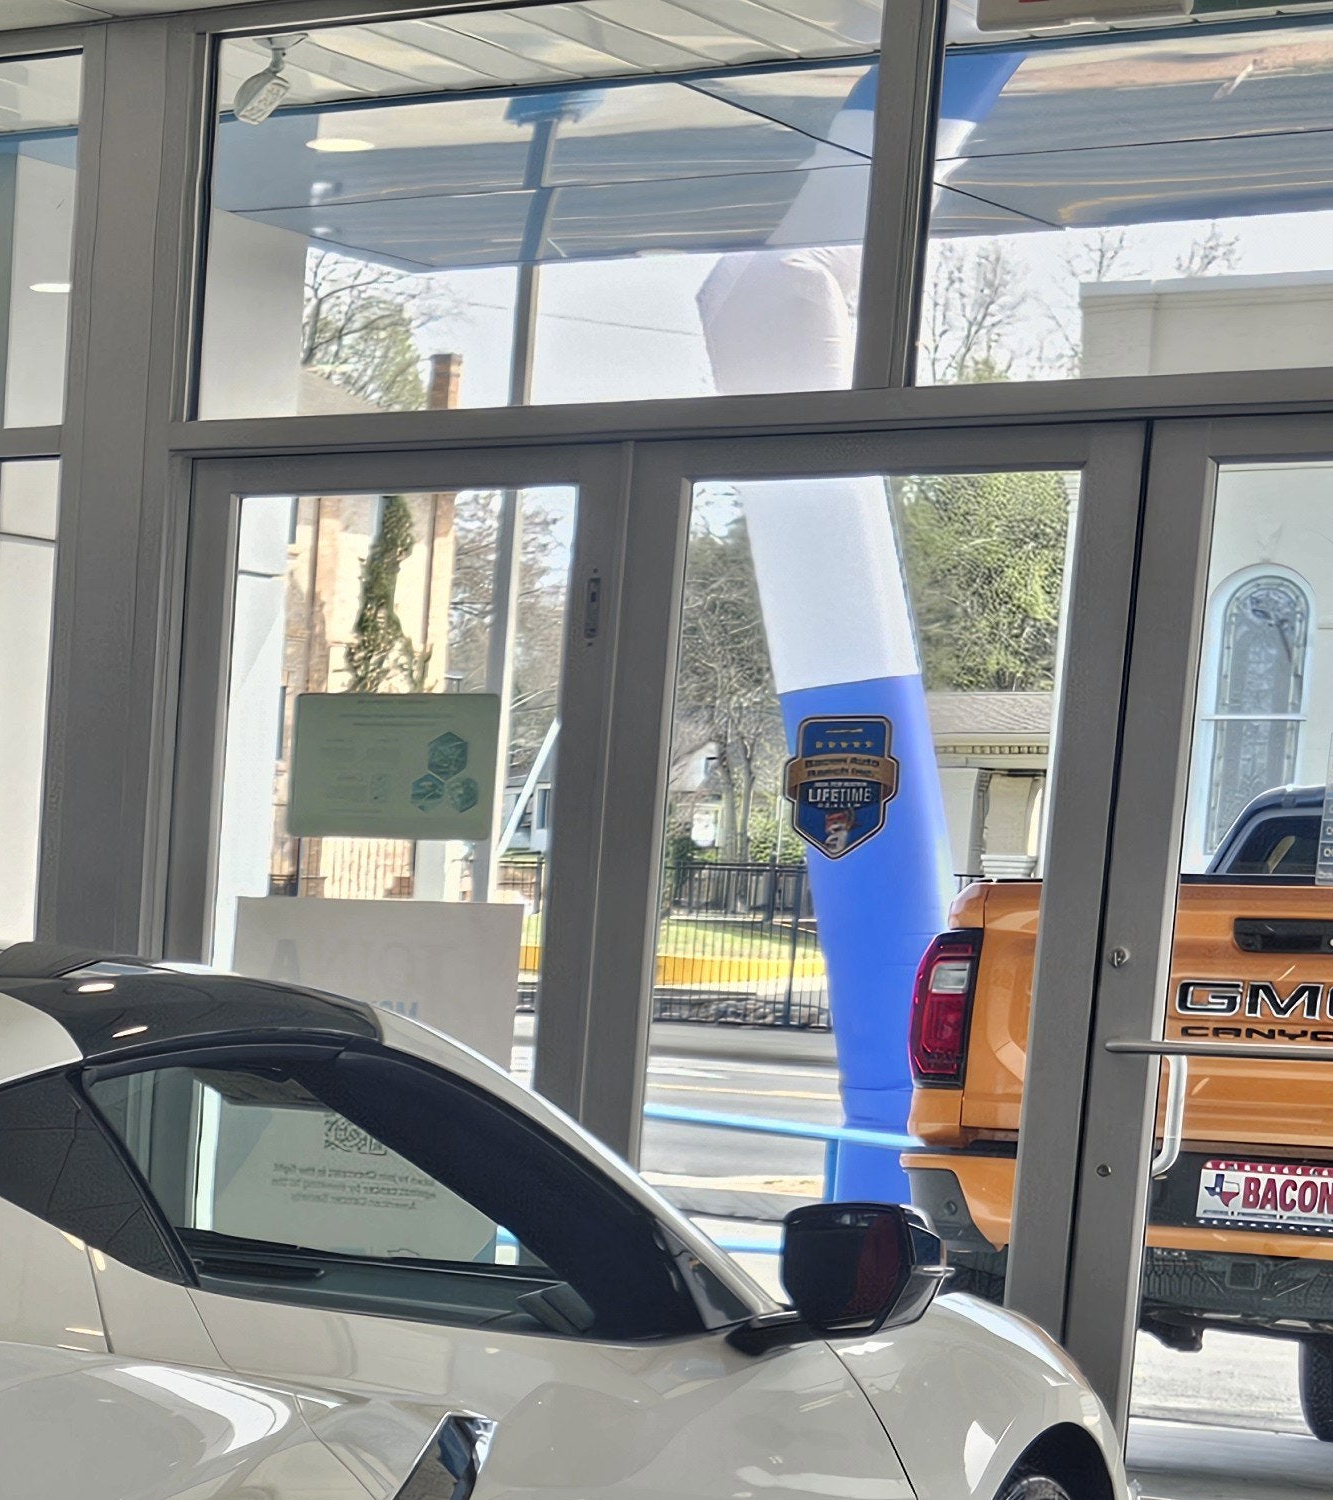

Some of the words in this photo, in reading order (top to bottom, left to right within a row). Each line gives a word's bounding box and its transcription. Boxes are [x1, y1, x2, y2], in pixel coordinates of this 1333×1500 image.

[808, 788, 872, 803] LIFETIME
[1176, 980, 1333, 1021] GM
[1242, 1176, 1333, 1215] BACON
